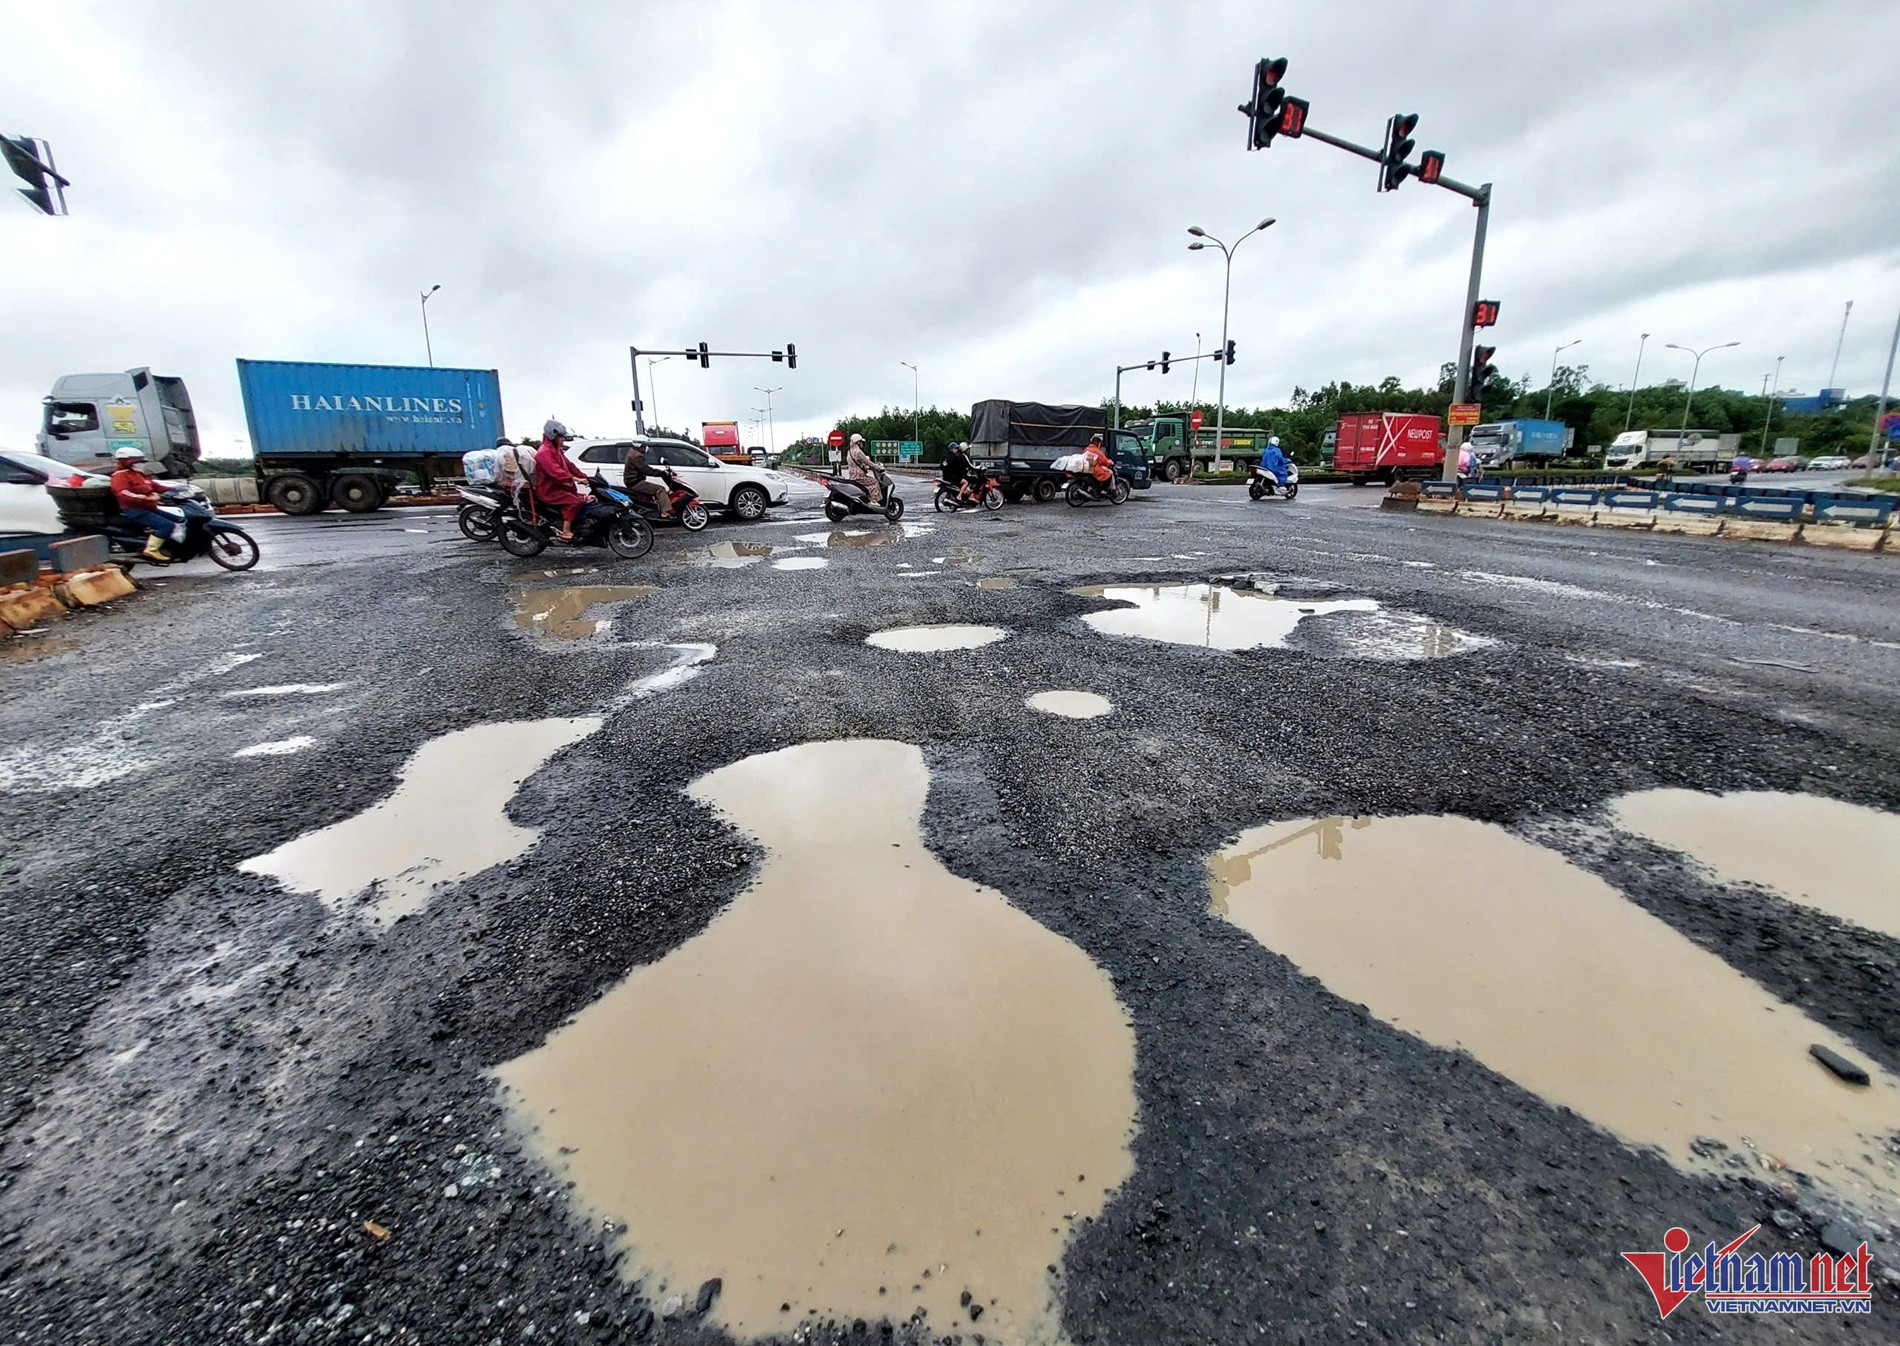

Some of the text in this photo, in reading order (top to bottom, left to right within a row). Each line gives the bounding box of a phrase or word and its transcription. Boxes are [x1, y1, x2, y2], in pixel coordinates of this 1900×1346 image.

[1282, 103, 1302, 132] 31
[1477, 303, 1496, 323] 31
[290, 394, 463, 413] HAIANLINES
[1407, 429, 1433, 439] NEWPOST
